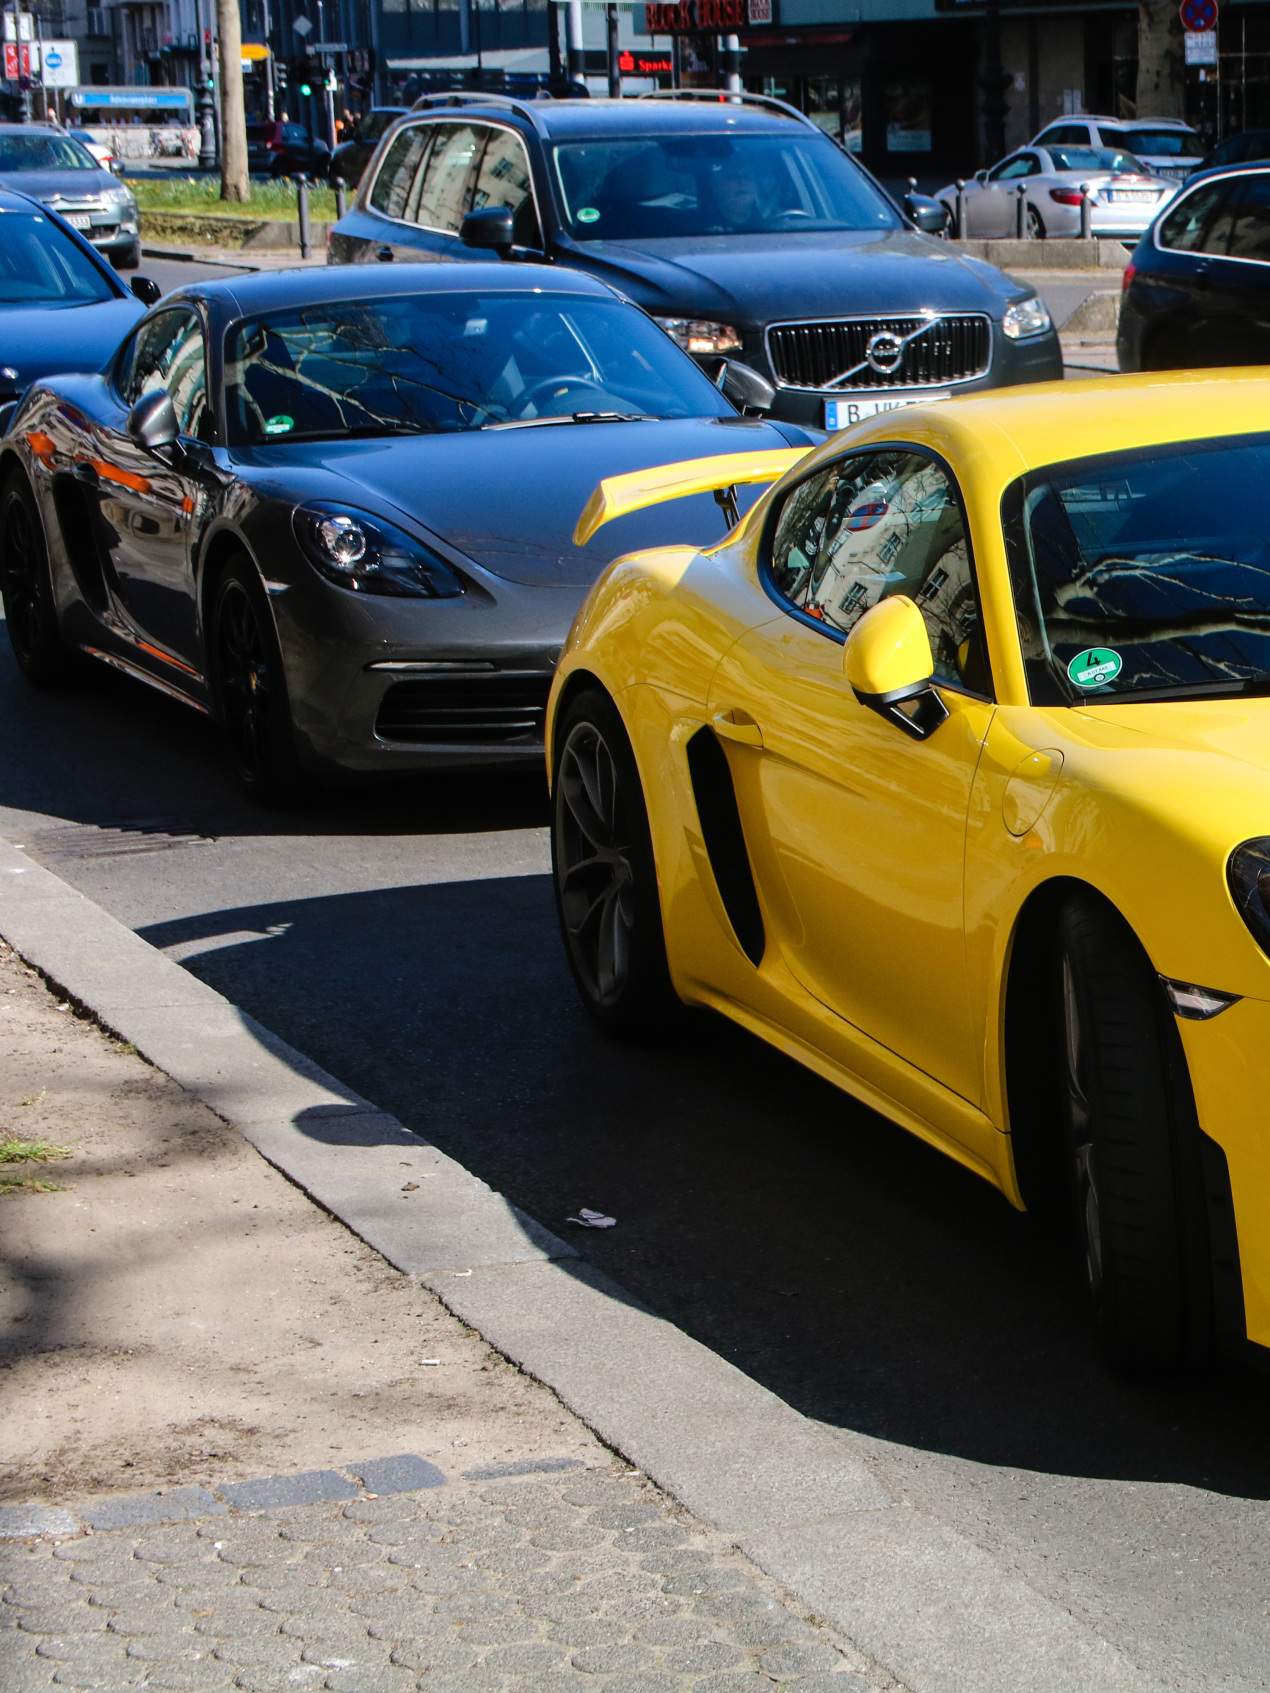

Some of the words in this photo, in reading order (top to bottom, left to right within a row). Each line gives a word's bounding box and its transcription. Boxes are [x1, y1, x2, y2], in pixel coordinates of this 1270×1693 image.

[645, 4, 691, 30] BLOCK
[698, 0, 744, 26] HOUSE
[848, 404, 860, 424] B
[1086, 652, 1101, 667] 4
